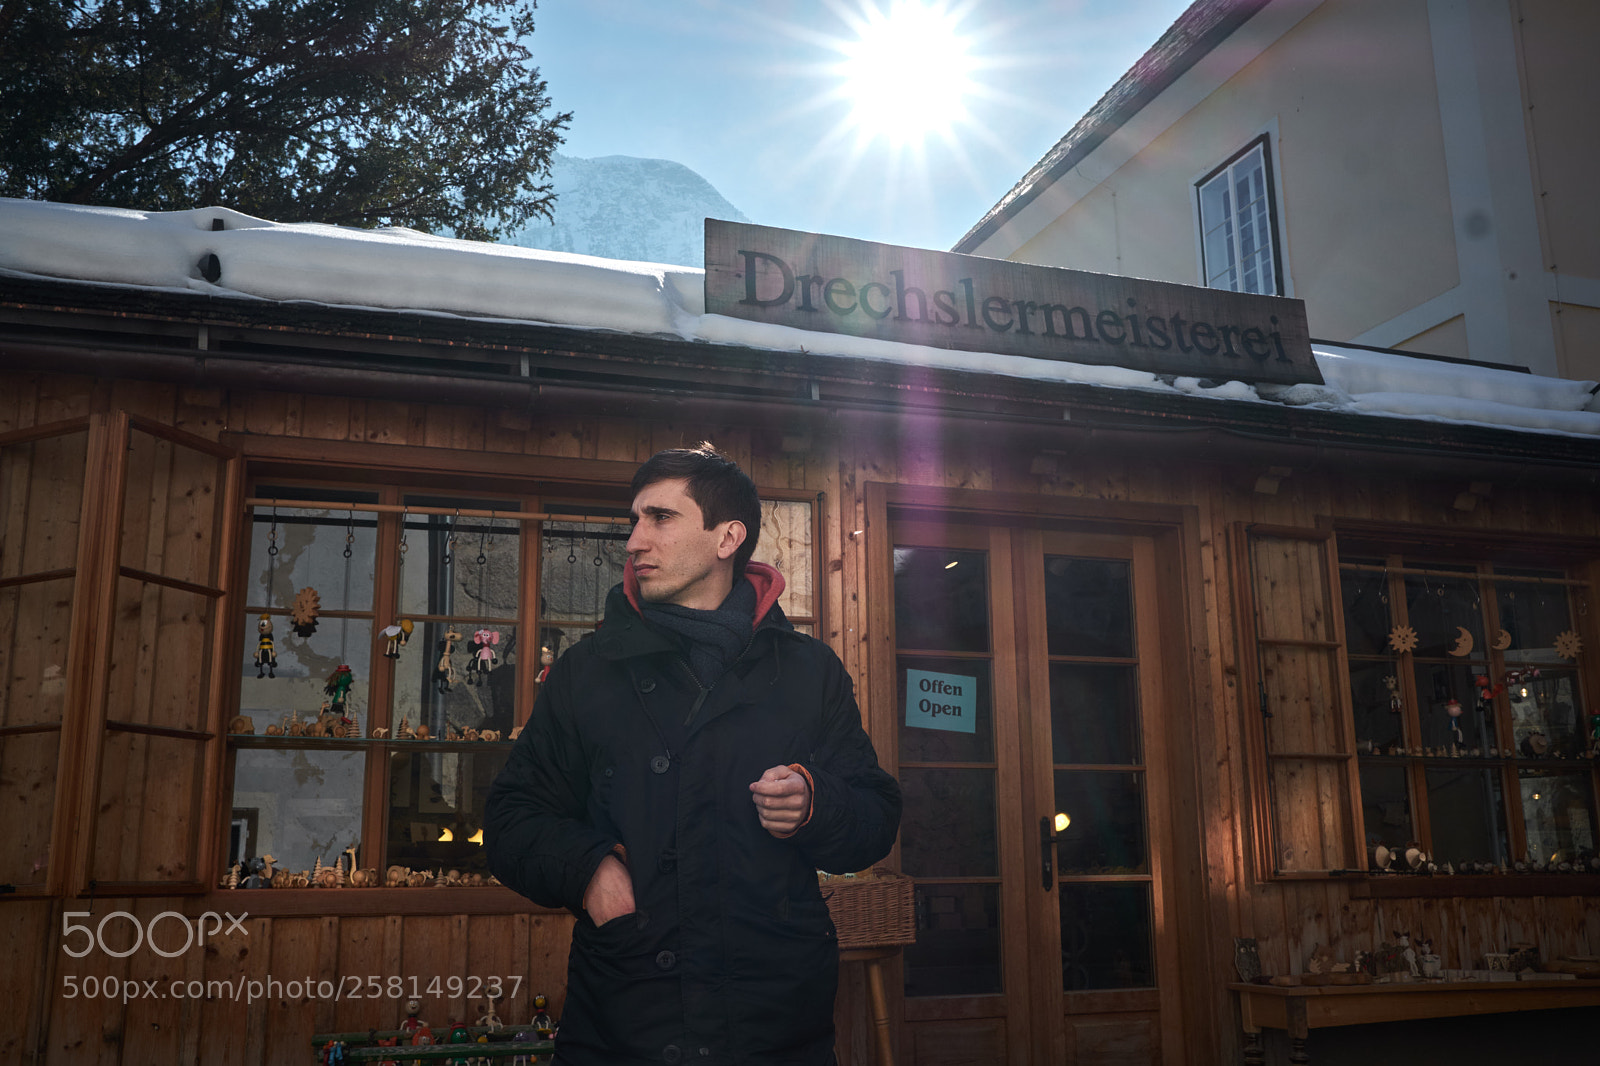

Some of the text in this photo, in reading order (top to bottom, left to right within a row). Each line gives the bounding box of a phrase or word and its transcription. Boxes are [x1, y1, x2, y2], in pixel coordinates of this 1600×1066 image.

[737, 249, 1293, 364] Drechslermeisterei
[919, 678, 962, 696] Offen
[919, 698, 962, 717] Open
